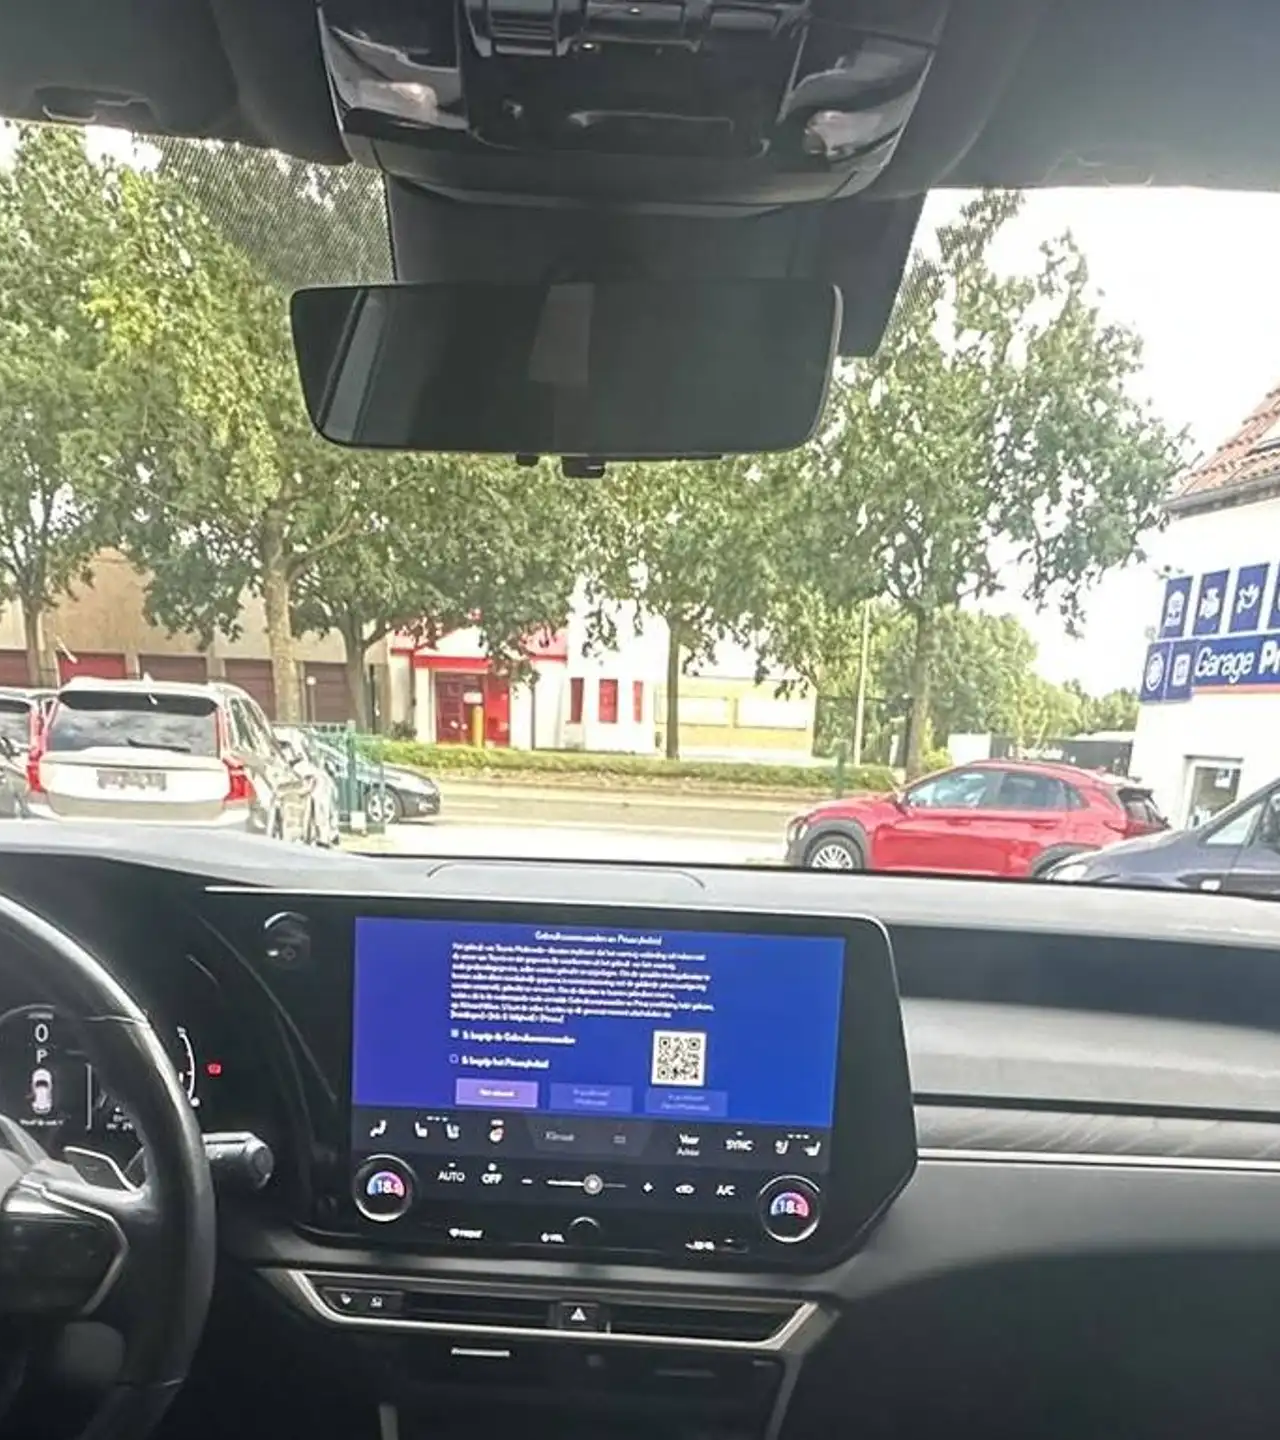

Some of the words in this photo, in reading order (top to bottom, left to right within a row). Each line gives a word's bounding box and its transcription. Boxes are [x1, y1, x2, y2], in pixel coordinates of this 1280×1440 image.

[1194, 647, 1255, 684] Garage
[36, 1050, 48, 1064] P
[437, 1171, 466, 1182] AUTO
[481, 1174, 503, 1184] OFF
[716, 1184, 736, 1196] A/C
